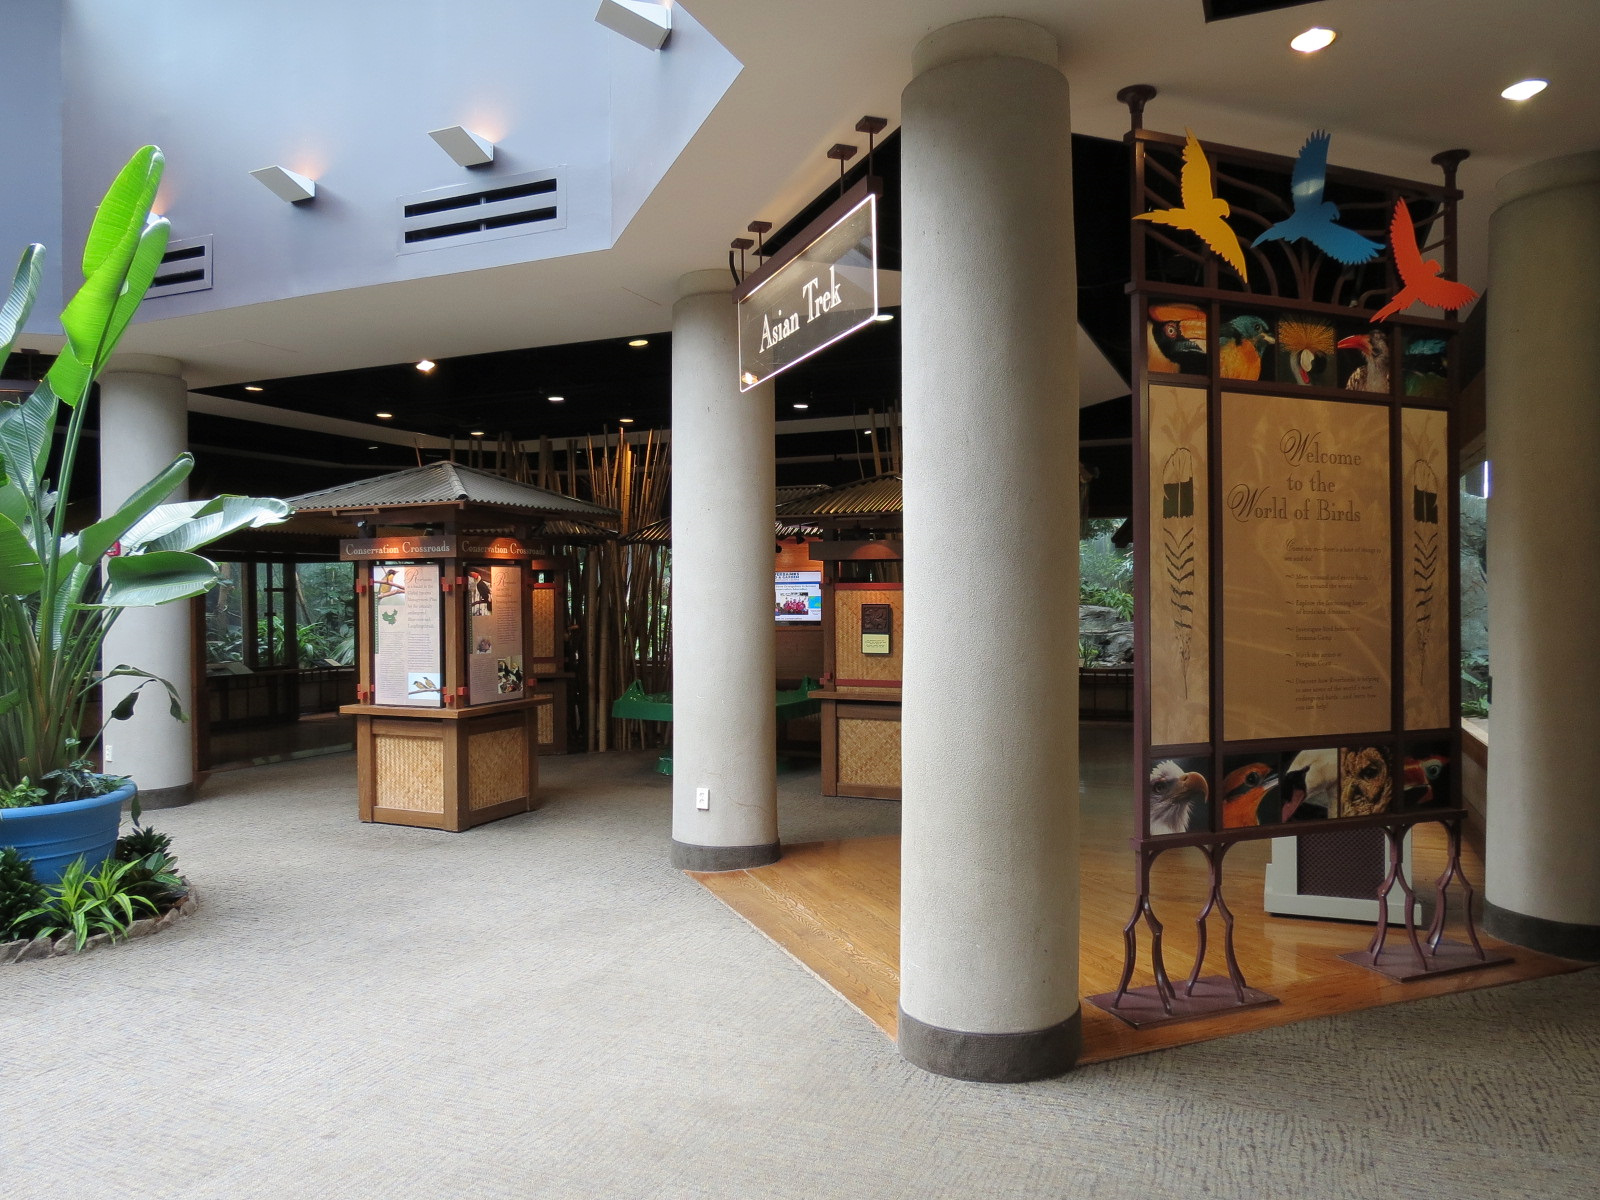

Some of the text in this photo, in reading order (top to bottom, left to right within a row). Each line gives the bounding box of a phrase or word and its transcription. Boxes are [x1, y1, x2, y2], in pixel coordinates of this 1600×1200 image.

[758, 264, 842, 354] Asian Trek
[1280, 428, 1362, 467] Welcome
[1286, 470, 1336, 493] to the
[1227, 483, 1361, 523] World of Birds
[345, 540, 450, 556] Conservation Crossroads
[461, 540, 546, 556] Conservation Crossroads
